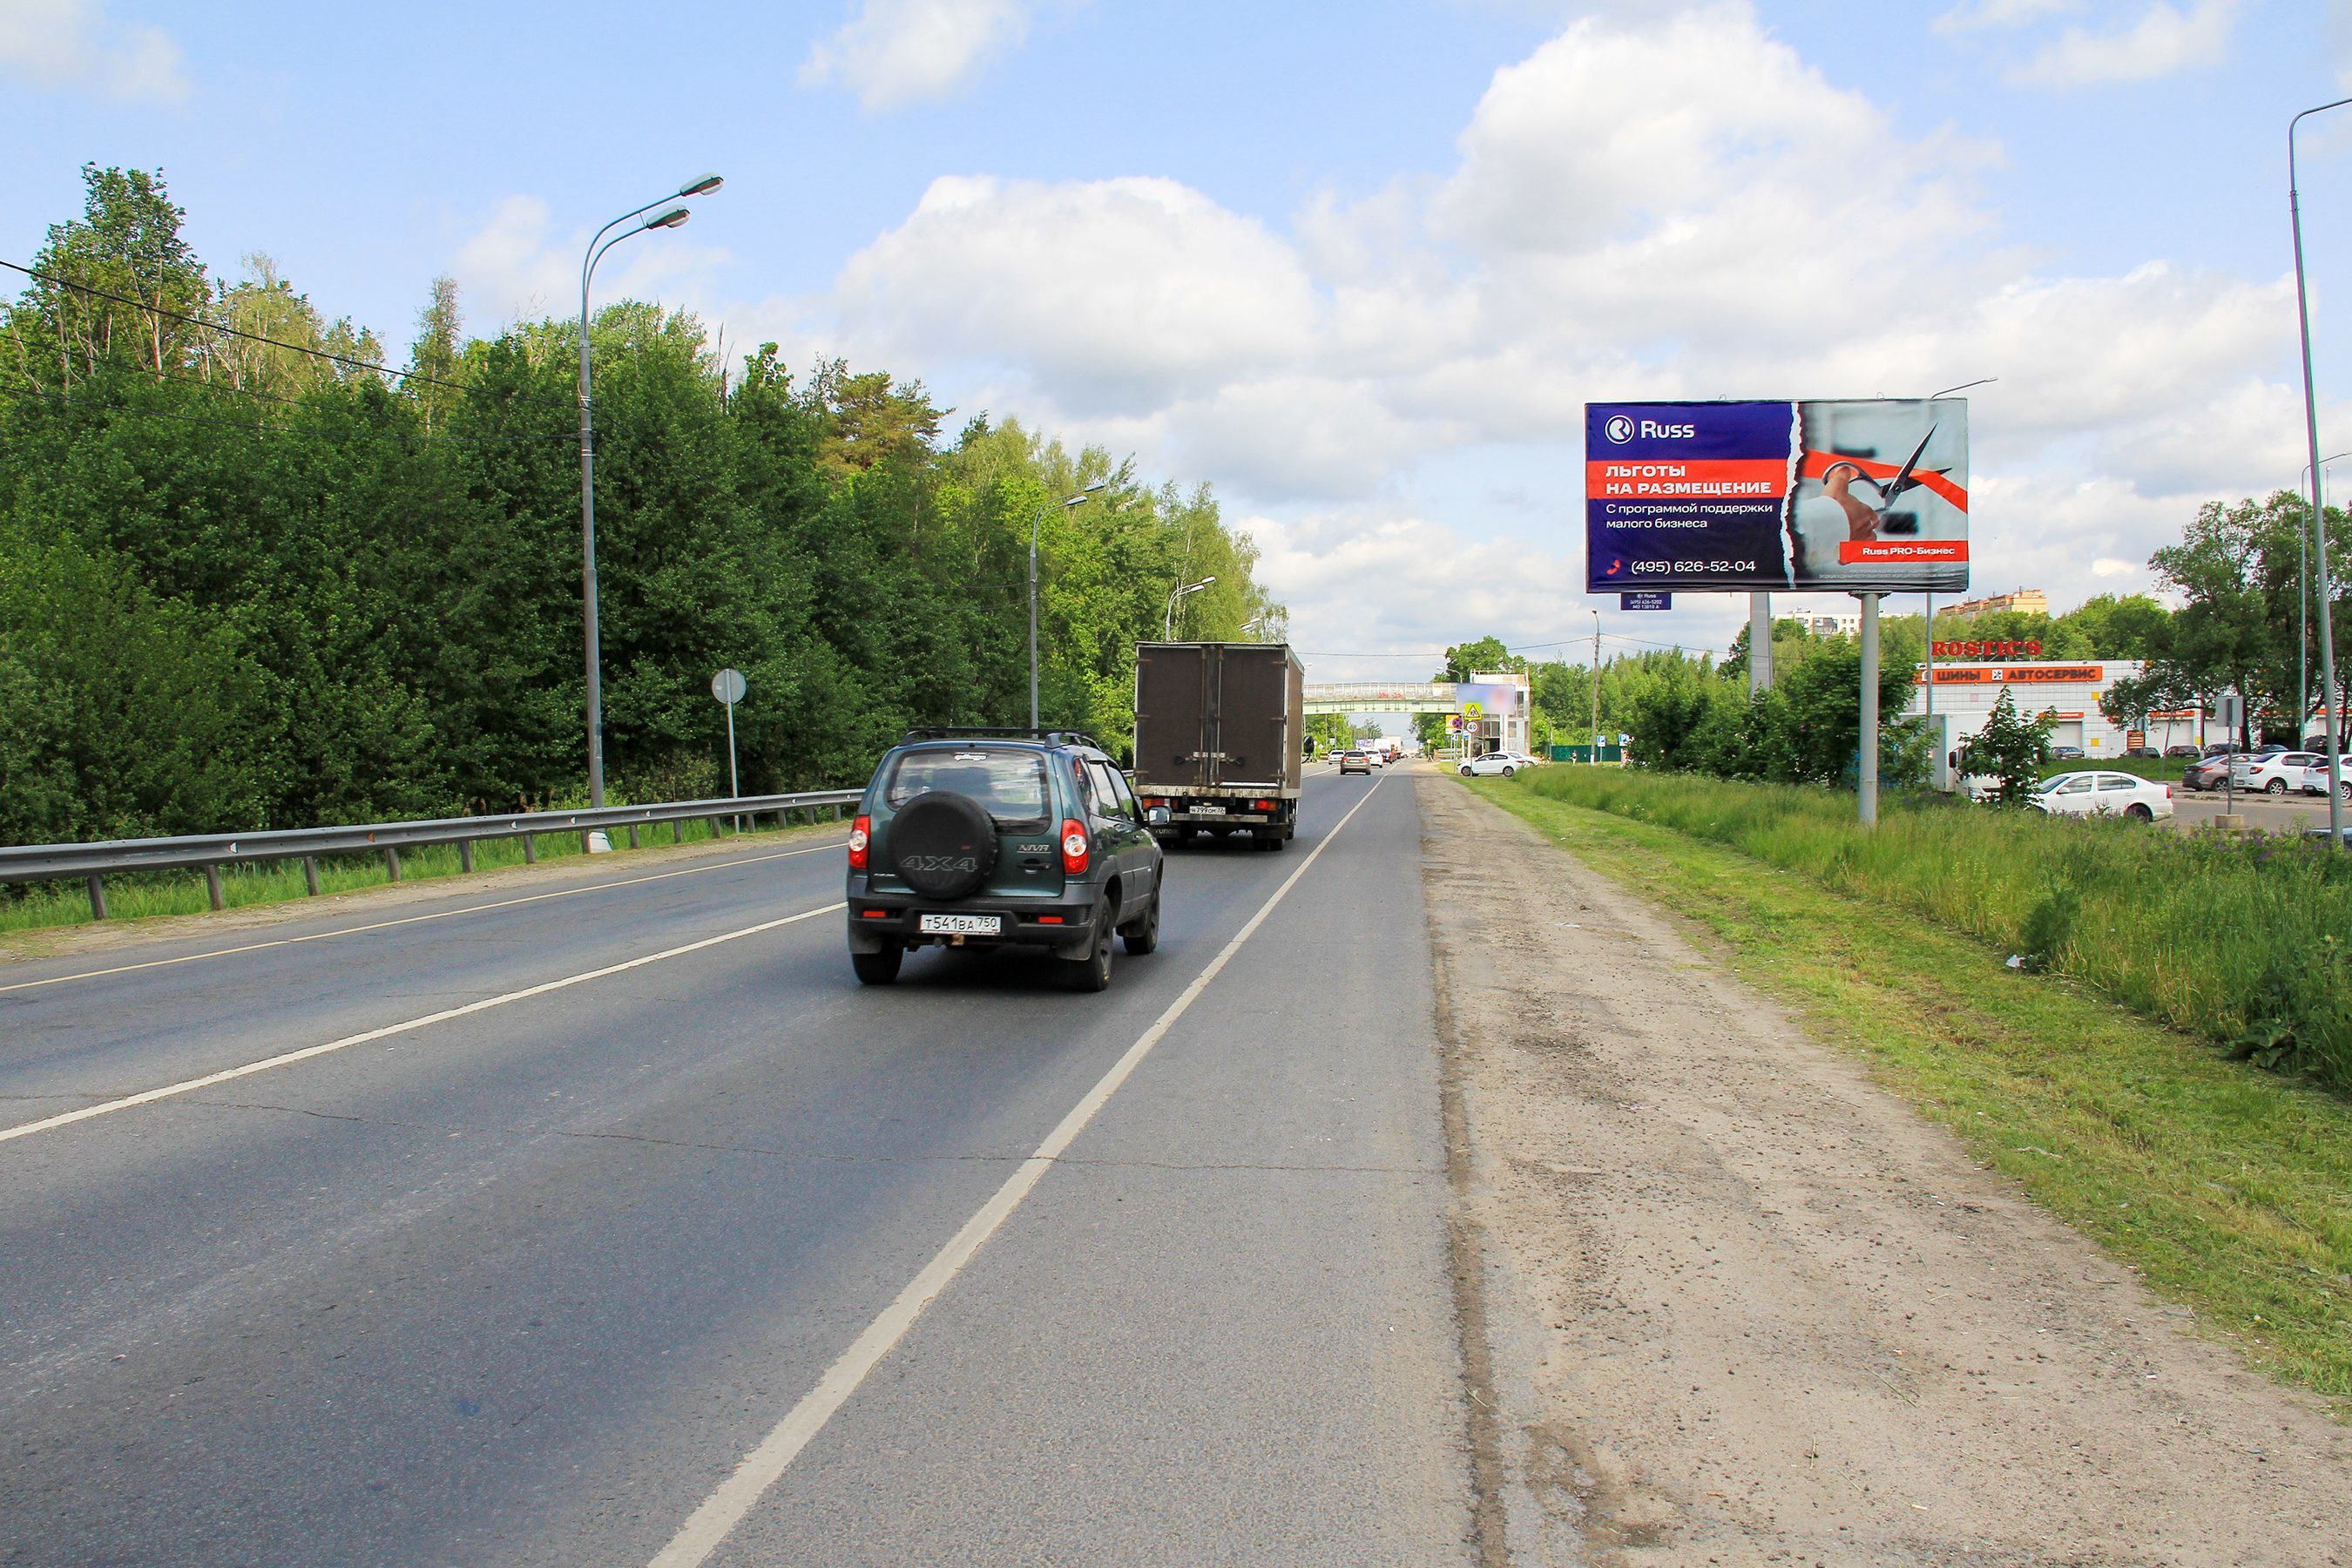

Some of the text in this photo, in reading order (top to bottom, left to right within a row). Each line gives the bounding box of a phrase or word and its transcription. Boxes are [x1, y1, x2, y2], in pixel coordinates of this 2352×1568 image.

[1640, 420, 1694, 439] Russ
[1605, 465, 1686, 477] ЛЬГОТЫ
[1605, 482, 1772, 496] НА РАЗМЕЩЕНИЕ
[1605, 503, 1773, 516] С программой поддержки
[1606, 517, 1707, 529] малого бизнеса
[1631, 560, 1756, 575] (495) 626-52-04
[1931, 640, 2043, 657] ROSTIC'S
[1937, 668, 2097, 681] ШИНЫ АВТОСЕРВИС
[977, 917, 997, 929] 750
